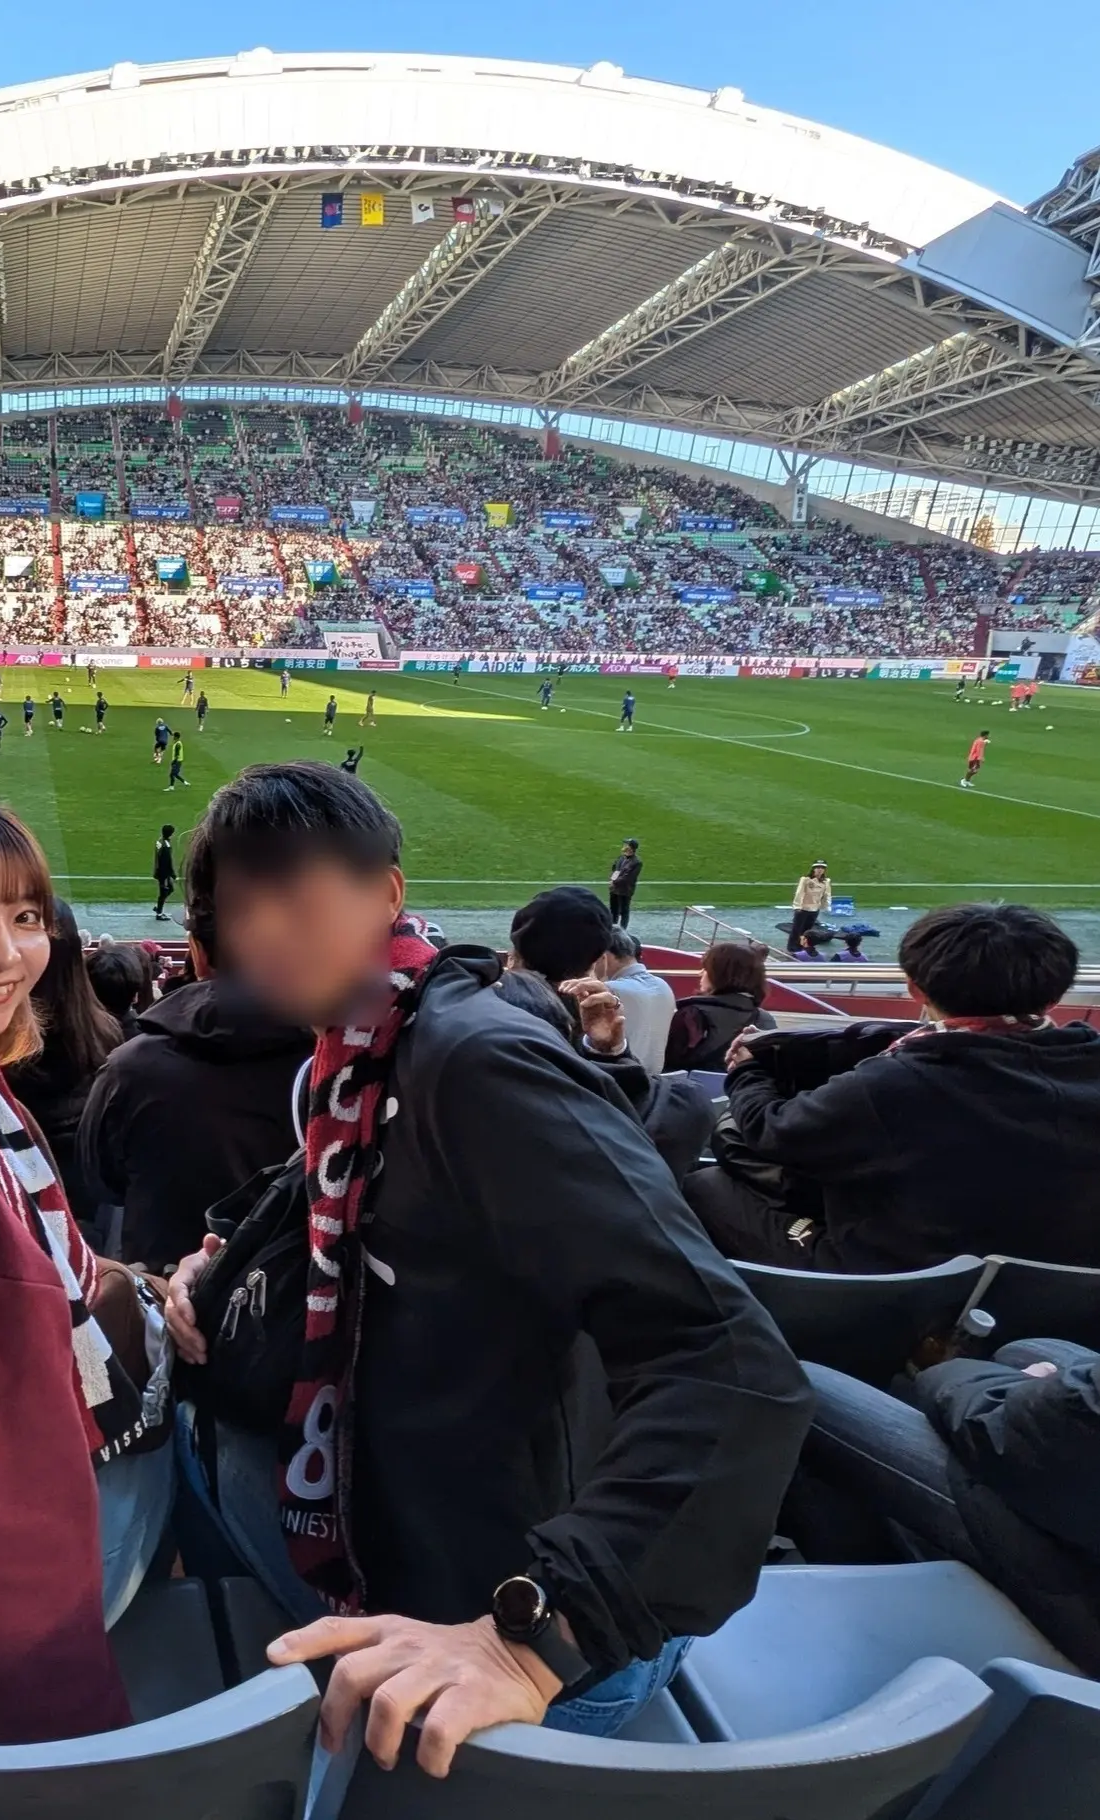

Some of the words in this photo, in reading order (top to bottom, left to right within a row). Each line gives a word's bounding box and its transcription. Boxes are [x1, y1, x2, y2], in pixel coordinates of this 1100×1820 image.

[150, 658, 192, 666] KONAMI
[224, 658, 265, 668] いちご
[284, 660, 326, 669] 明治安田
[482, 662, 524, 672] AiDEM
[687, 667, 725, 675] docmo
[751, 667, 791, 676] KONAMI
[821, 668, 860, 678] いちご
[880, 669, 921, 679] 明治安田
[286, 1384, 337, 1500] 8
